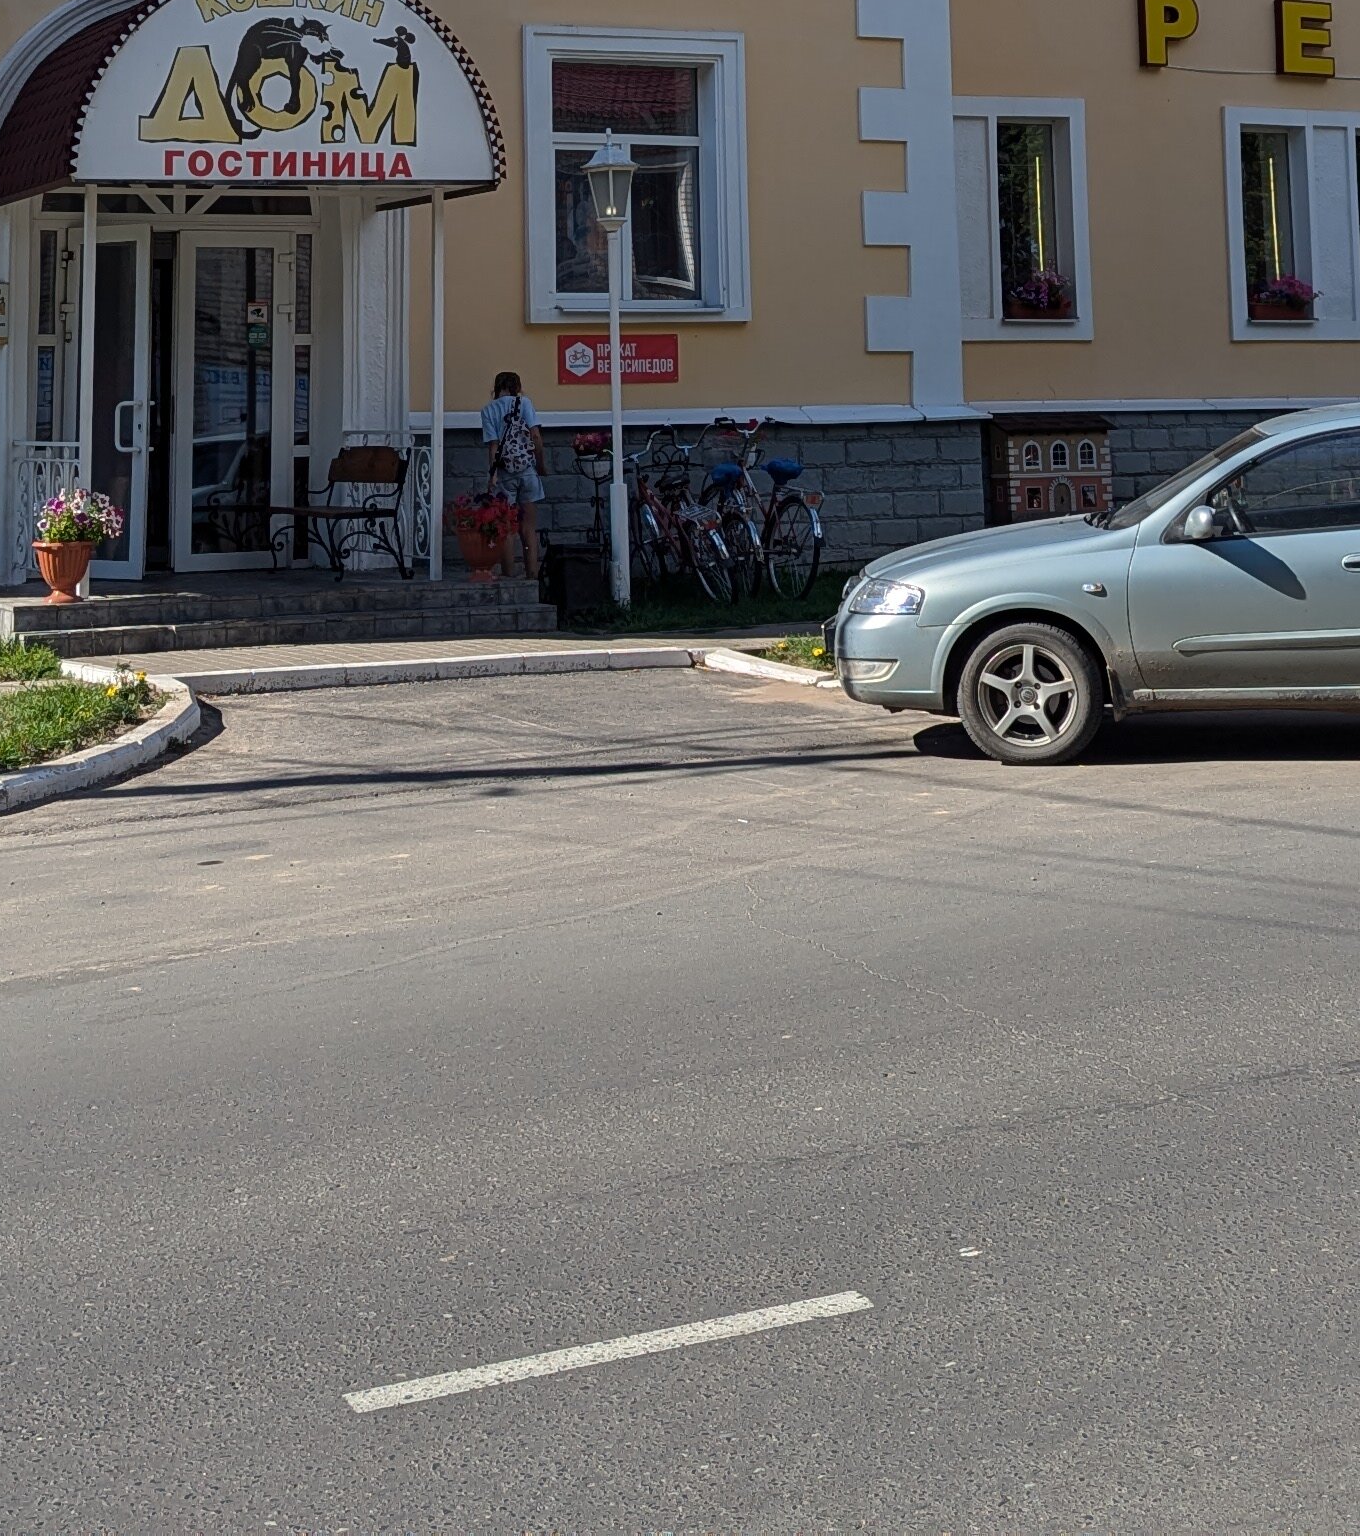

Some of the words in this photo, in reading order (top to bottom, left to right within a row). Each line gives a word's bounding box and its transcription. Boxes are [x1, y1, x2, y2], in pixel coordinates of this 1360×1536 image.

[138, 45, 420, 147] ДОМ
[163, 150, 412, 181] ГОСТИНИЦА
[596, 343, 637, 357] ПРКАТ
[597, 358, 674, 374] ВЕОСИПЕДОВ
